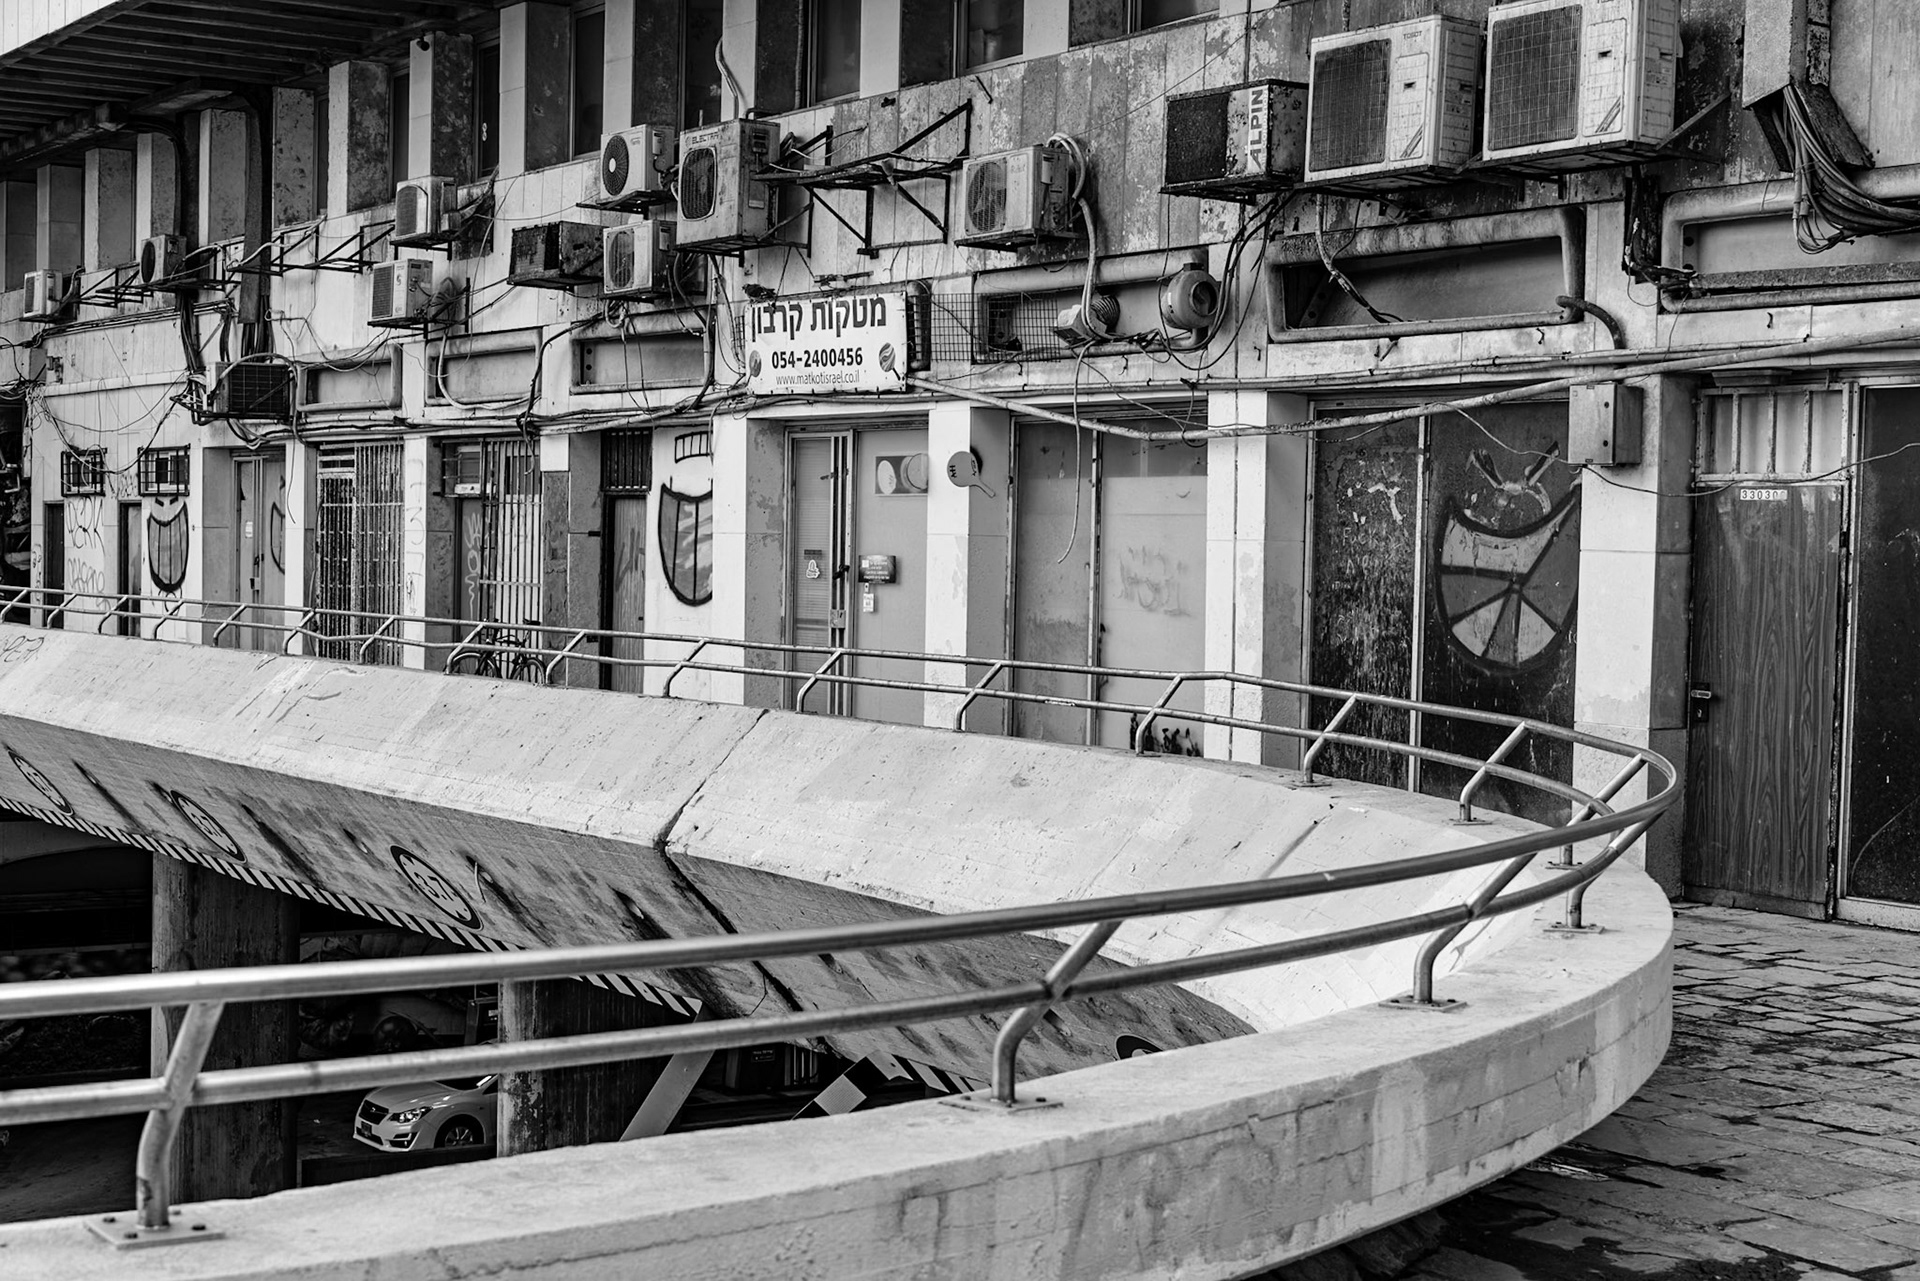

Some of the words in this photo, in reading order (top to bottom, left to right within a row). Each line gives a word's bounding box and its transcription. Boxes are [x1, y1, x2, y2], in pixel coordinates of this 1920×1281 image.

[1249, 89, 1264, 171] ALPIN
[751, 302, 804, 343] קרבון
[810, 296, 887, 338] מטקות
[771, 347, 864, 369] 054-2400456
[775, 369, 861, 386] www.matkotisrael.co.il
[413, 871, 455, 902] 3.7
